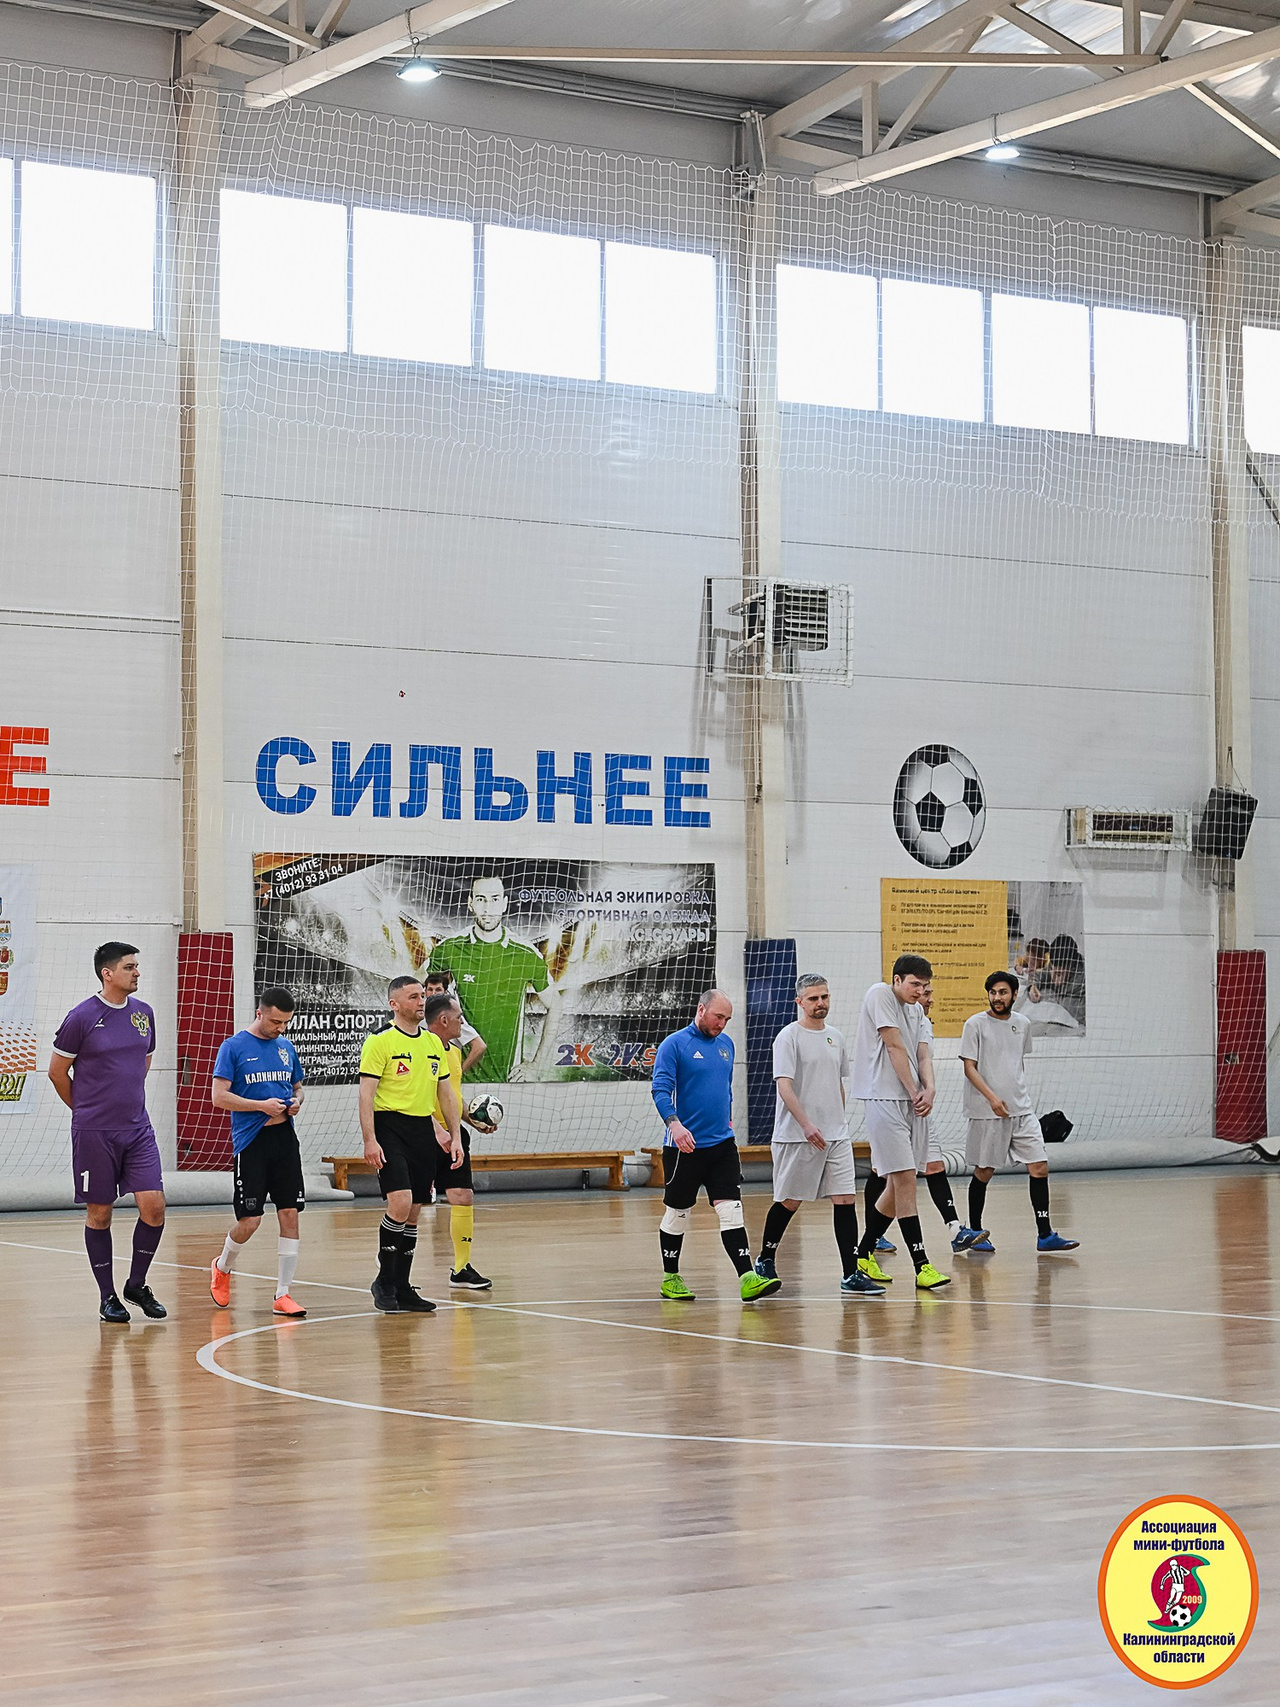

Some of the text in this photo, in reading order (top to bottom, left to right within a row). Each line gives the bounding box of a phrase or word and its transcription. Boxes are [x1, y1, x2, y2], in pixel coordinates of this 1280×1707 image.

[255, 736, 712, 829] СИЛЬНЕЕ
[275, 857, 322, 882] ЗВОНИТЕ:
[263, 863, 344, 901] +7 (4012) 93 31 04
[519, 889, 711, 904] ФУТБОЛЬНАЯ ЭКИПИРОВКА
[556, 909, 711, 923] СПОРТИВНАЯ ОДЕЖДА
[287, 1014, 385, 1030] ИЛАН СПОРТ
[284, 1029, 336, 1042] ИЦИАЛЬНЫЙ
[294, 1041, 361, 1053] ЛИНИНГРАДСКОЙ
[555, 1043, 597, 1067] 2K
[244, 1070, 292, 1085] КАЛИНИНГР
[323, 1067, 348, 1077] (4012)
[80, 1170, 90, 1193] 1
